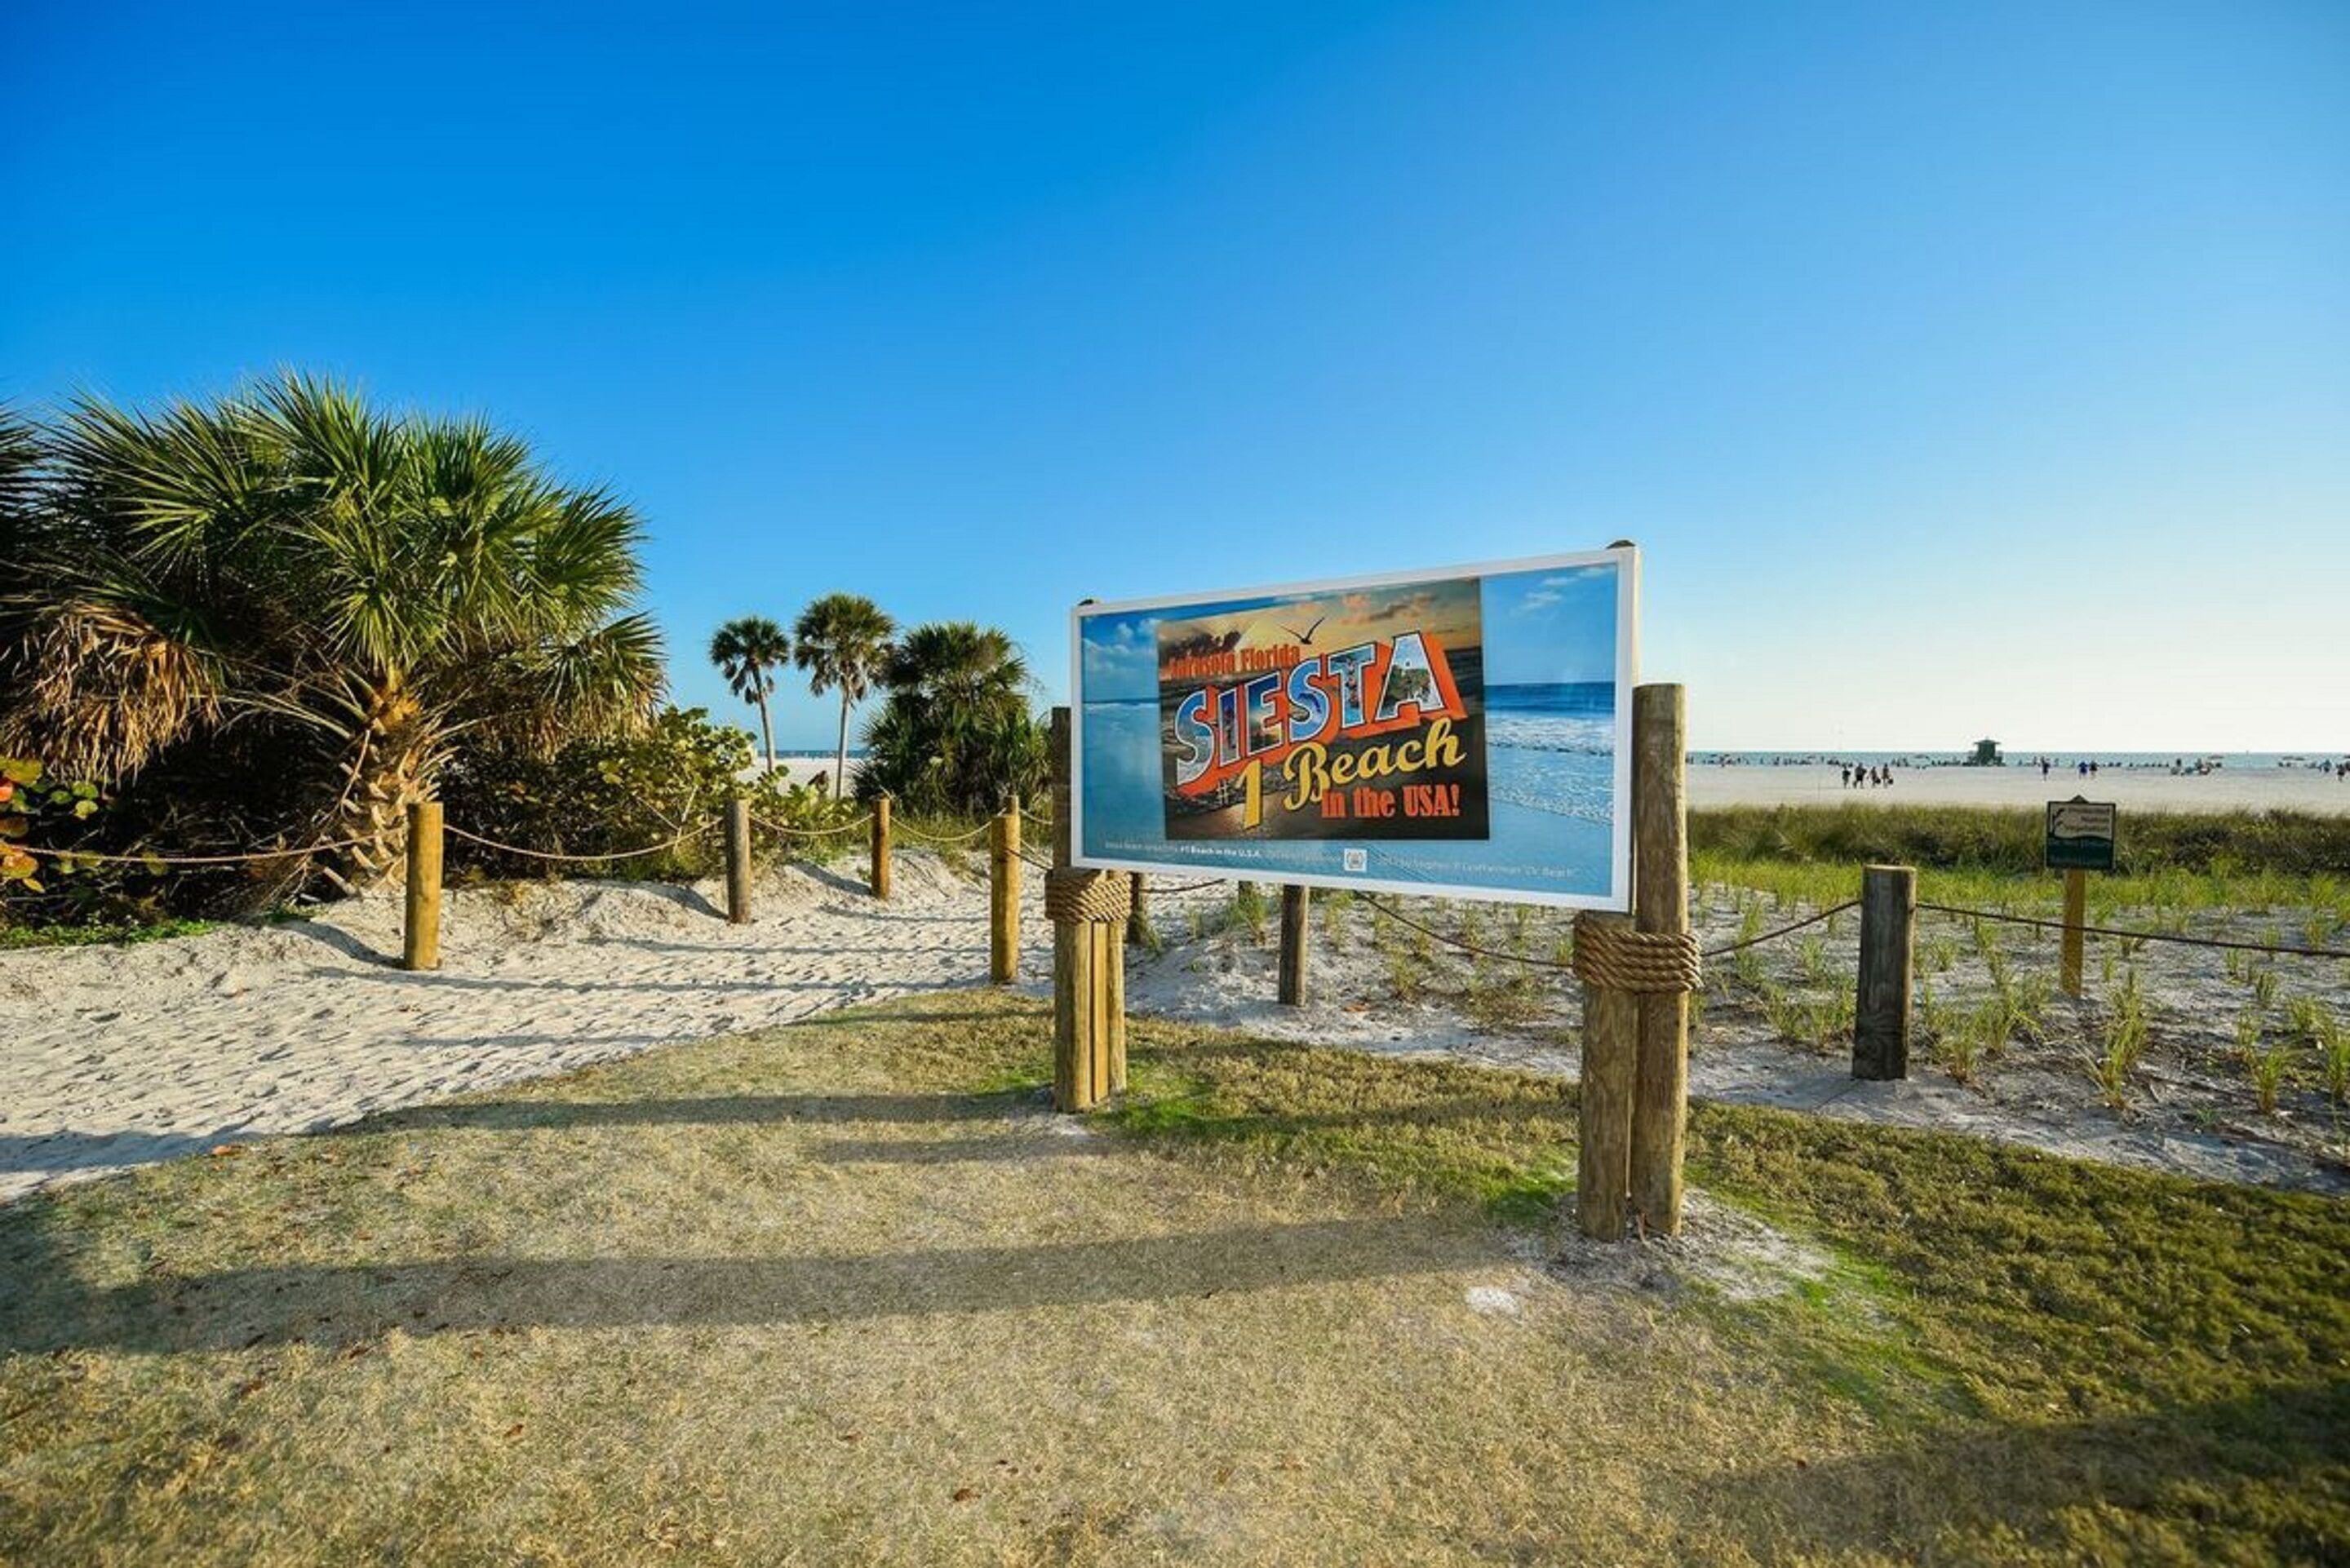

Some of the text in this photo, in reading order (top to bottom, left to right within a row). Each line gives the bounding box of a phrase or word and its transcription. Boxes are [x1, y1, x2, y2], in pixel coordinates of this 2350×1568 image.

[1240, 643, 1301, 673] Florida
[1175, 631, 1459, 788] SIESTA
[1283, 717, 1467, 811] Beach
[1352, 786, 1395, 817] the
[1402, 783, 1461, 817] USA!
